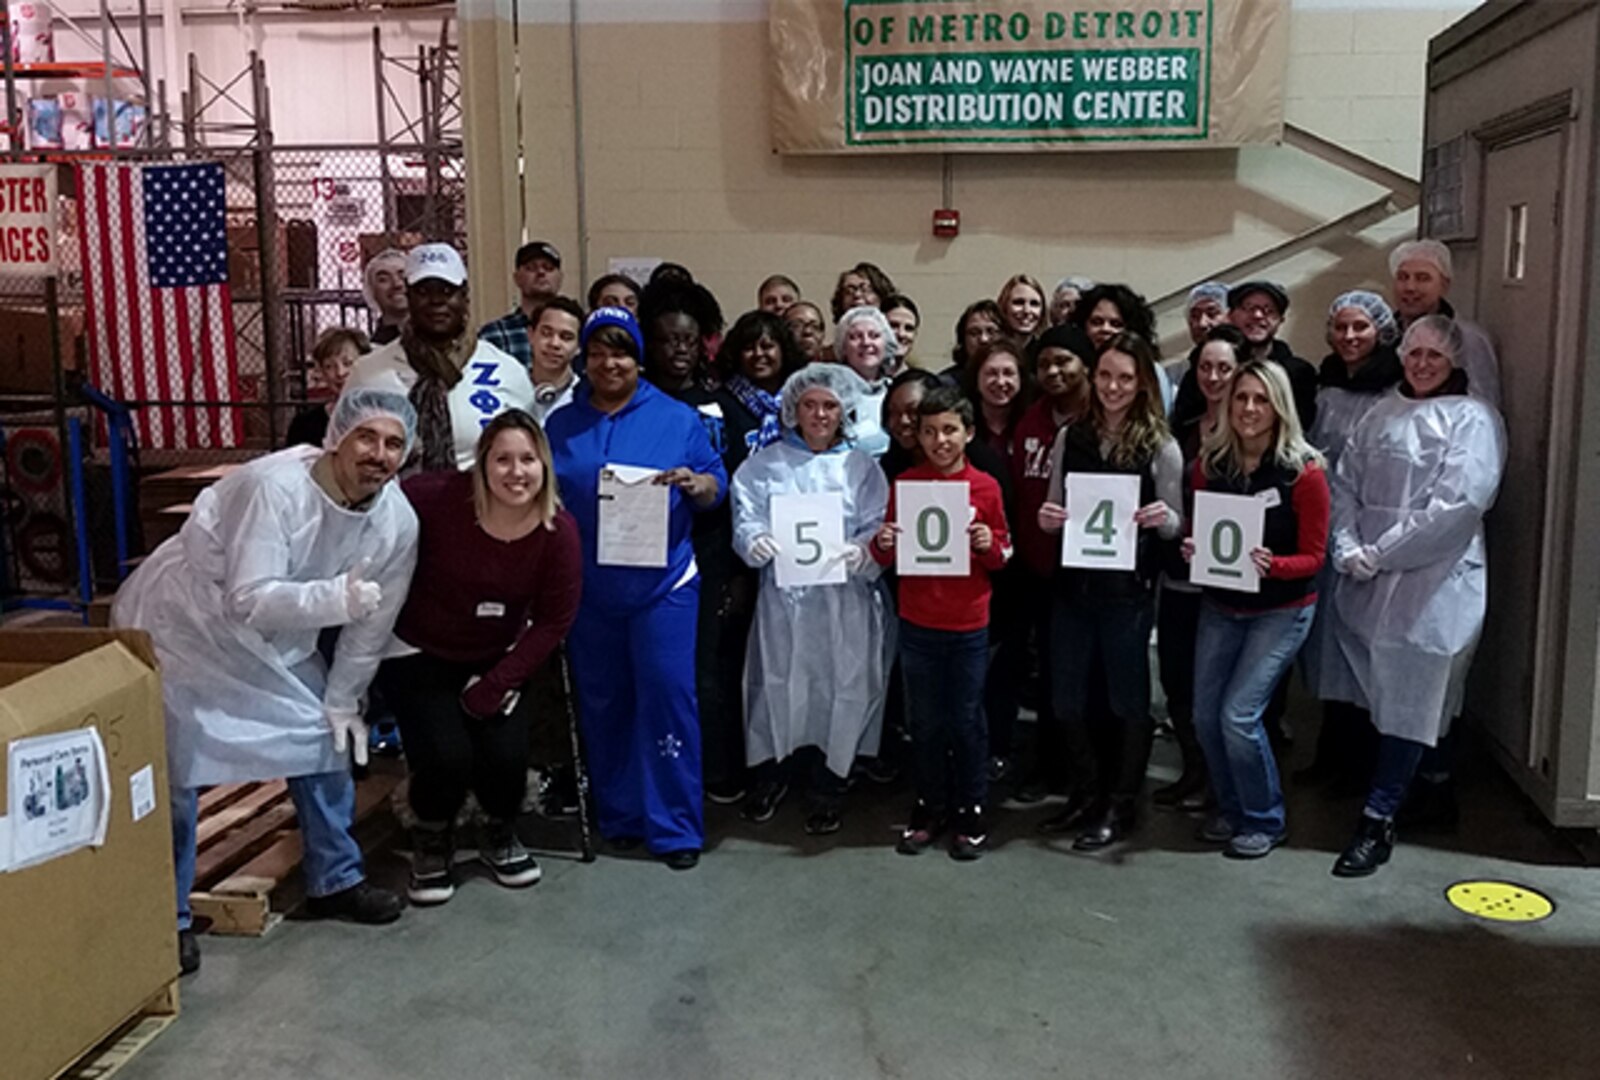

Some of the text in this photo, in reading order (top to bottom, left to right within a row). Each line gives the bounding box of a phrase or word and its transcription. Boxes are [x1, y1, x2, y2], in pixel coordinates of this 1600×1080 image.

[854, 10, 1203, 45] OF METRO DETROIT
[860, 56, 1188, 94] JOAN AND WAYNE WEBBER
[864, 90, 1186, 124] DISTRIBUTION CENTER
[312, 177, 336, 201] 13
[915, 506, 951, 552] 0
[1083, 499, 1118, 546] 4
[1210, 519, 1244, 565] 0
[794, 521, 823, 566] 5
